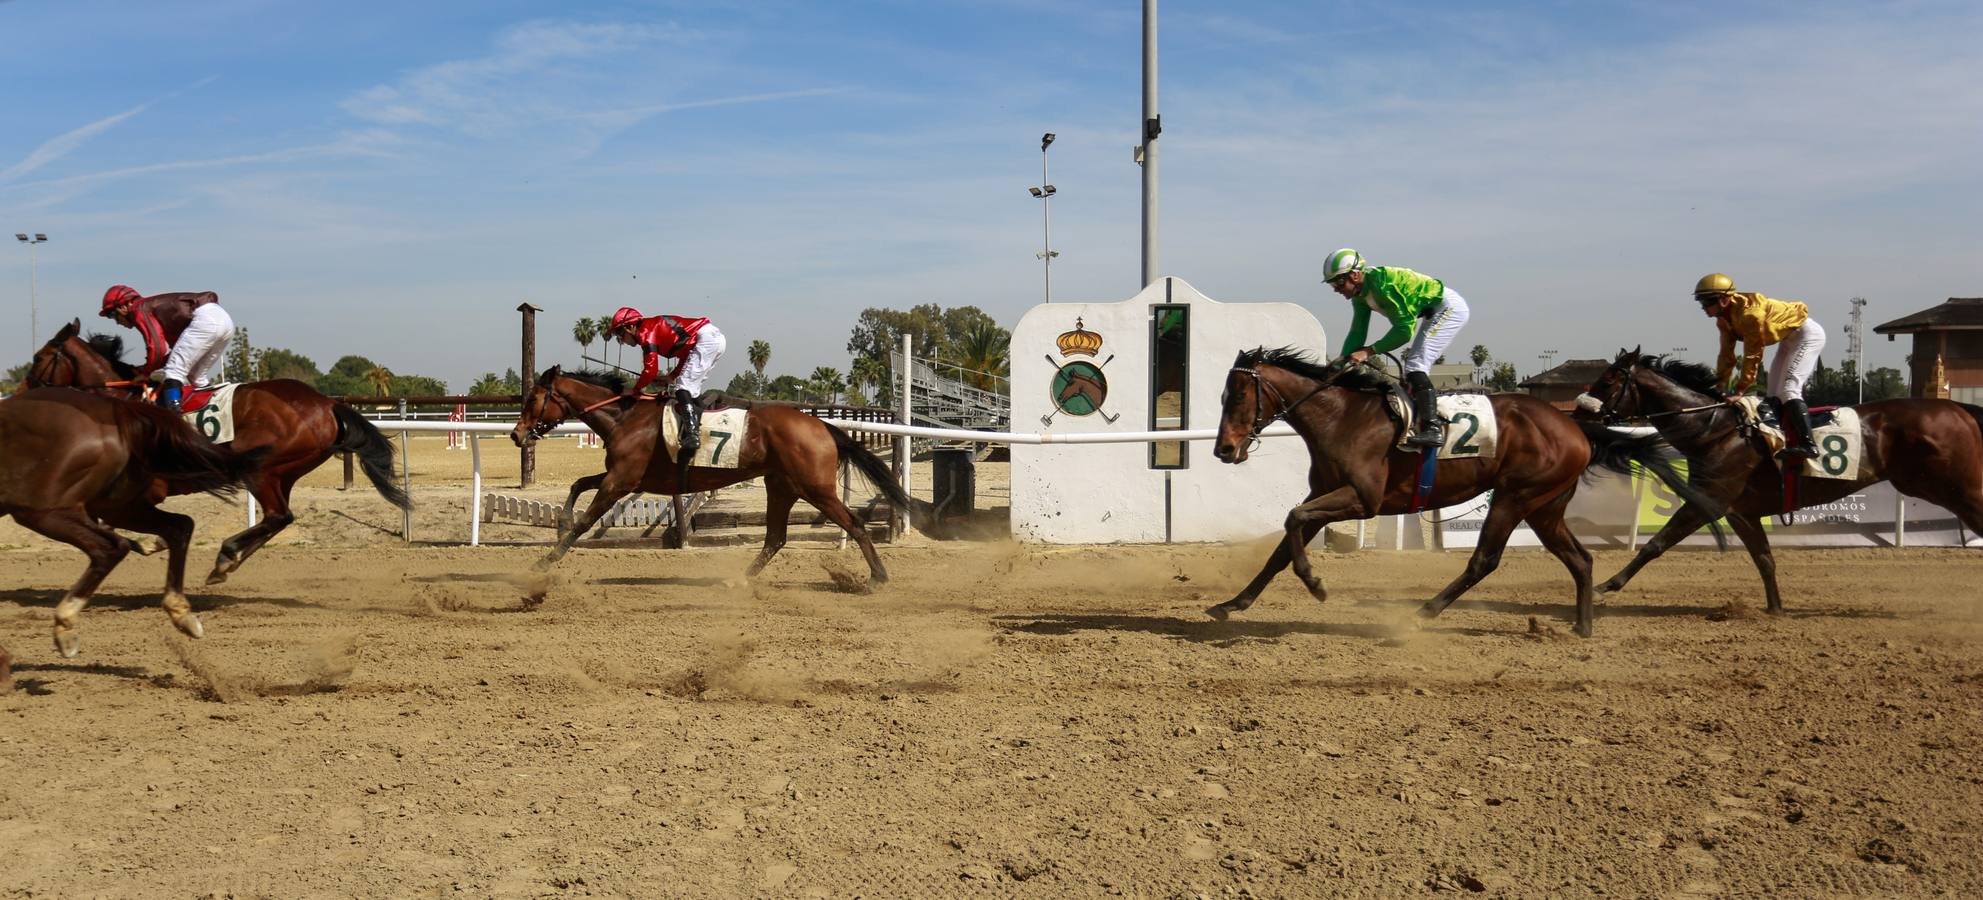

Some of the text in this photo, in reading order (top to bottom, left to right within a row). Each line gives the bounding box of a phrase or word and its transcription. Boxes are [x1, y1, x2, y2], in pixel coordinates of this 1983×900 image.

[196, 404, 221, 442] 6
[1451, 412, 1480, 454] 2
[710, 431, 733, 465] 7
[1822, 434, 1848, 475] 8
[1449, 522, 1473, 530] REAL
